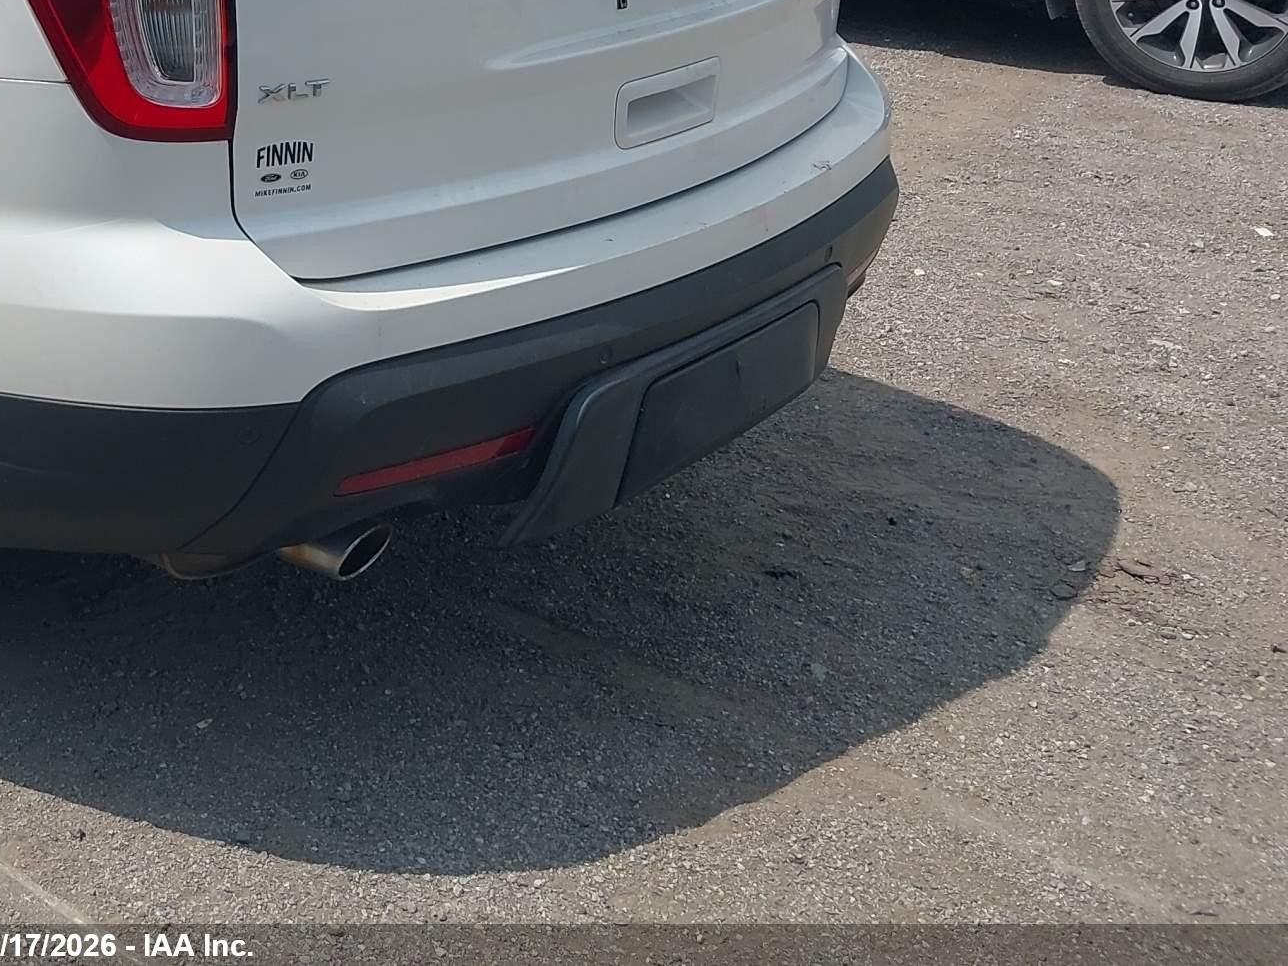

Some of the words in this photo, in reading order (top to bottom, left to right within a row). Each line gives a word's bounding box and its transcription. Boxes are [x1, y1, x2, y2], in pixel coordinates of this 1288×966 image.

[257, 78, 331, 105] XLT
[256, 141, 314, 169] FINNIN
[255, 184, 311, 197] MIKEFINNIN.COM
